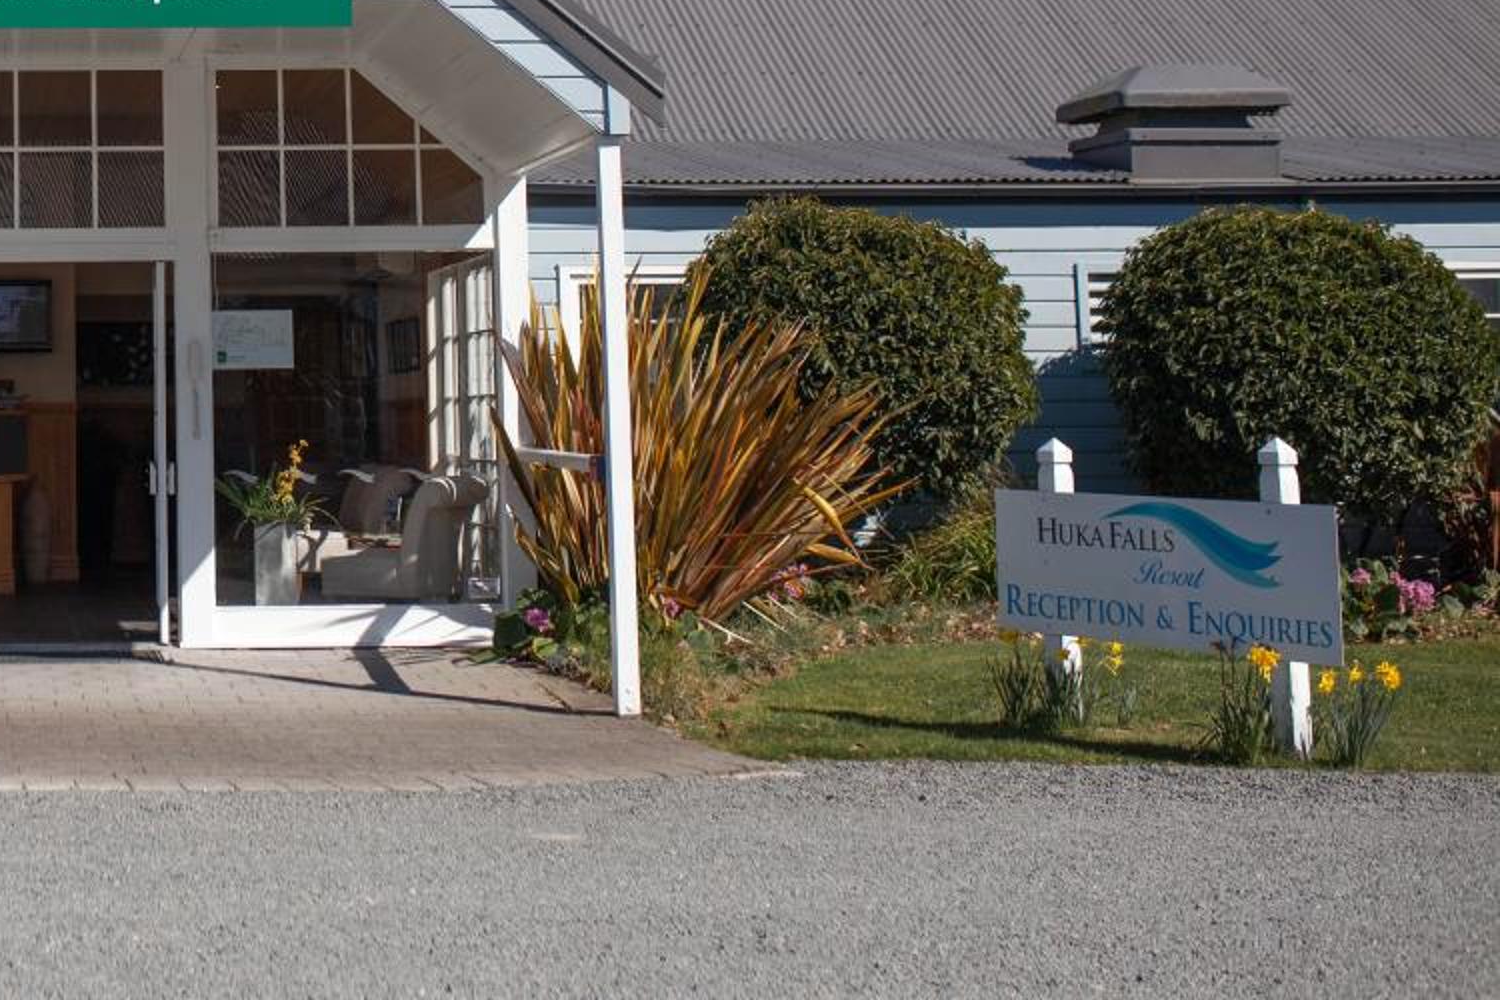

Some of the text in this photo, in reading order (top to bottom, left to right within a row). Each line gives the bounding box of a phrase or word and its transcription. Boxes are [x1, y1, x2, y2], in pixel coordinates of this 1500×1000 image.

[1132, 558, 1205, 590] Resort
[1006, 583, 1334, 649] RECEPTION & ENQUIRIES
